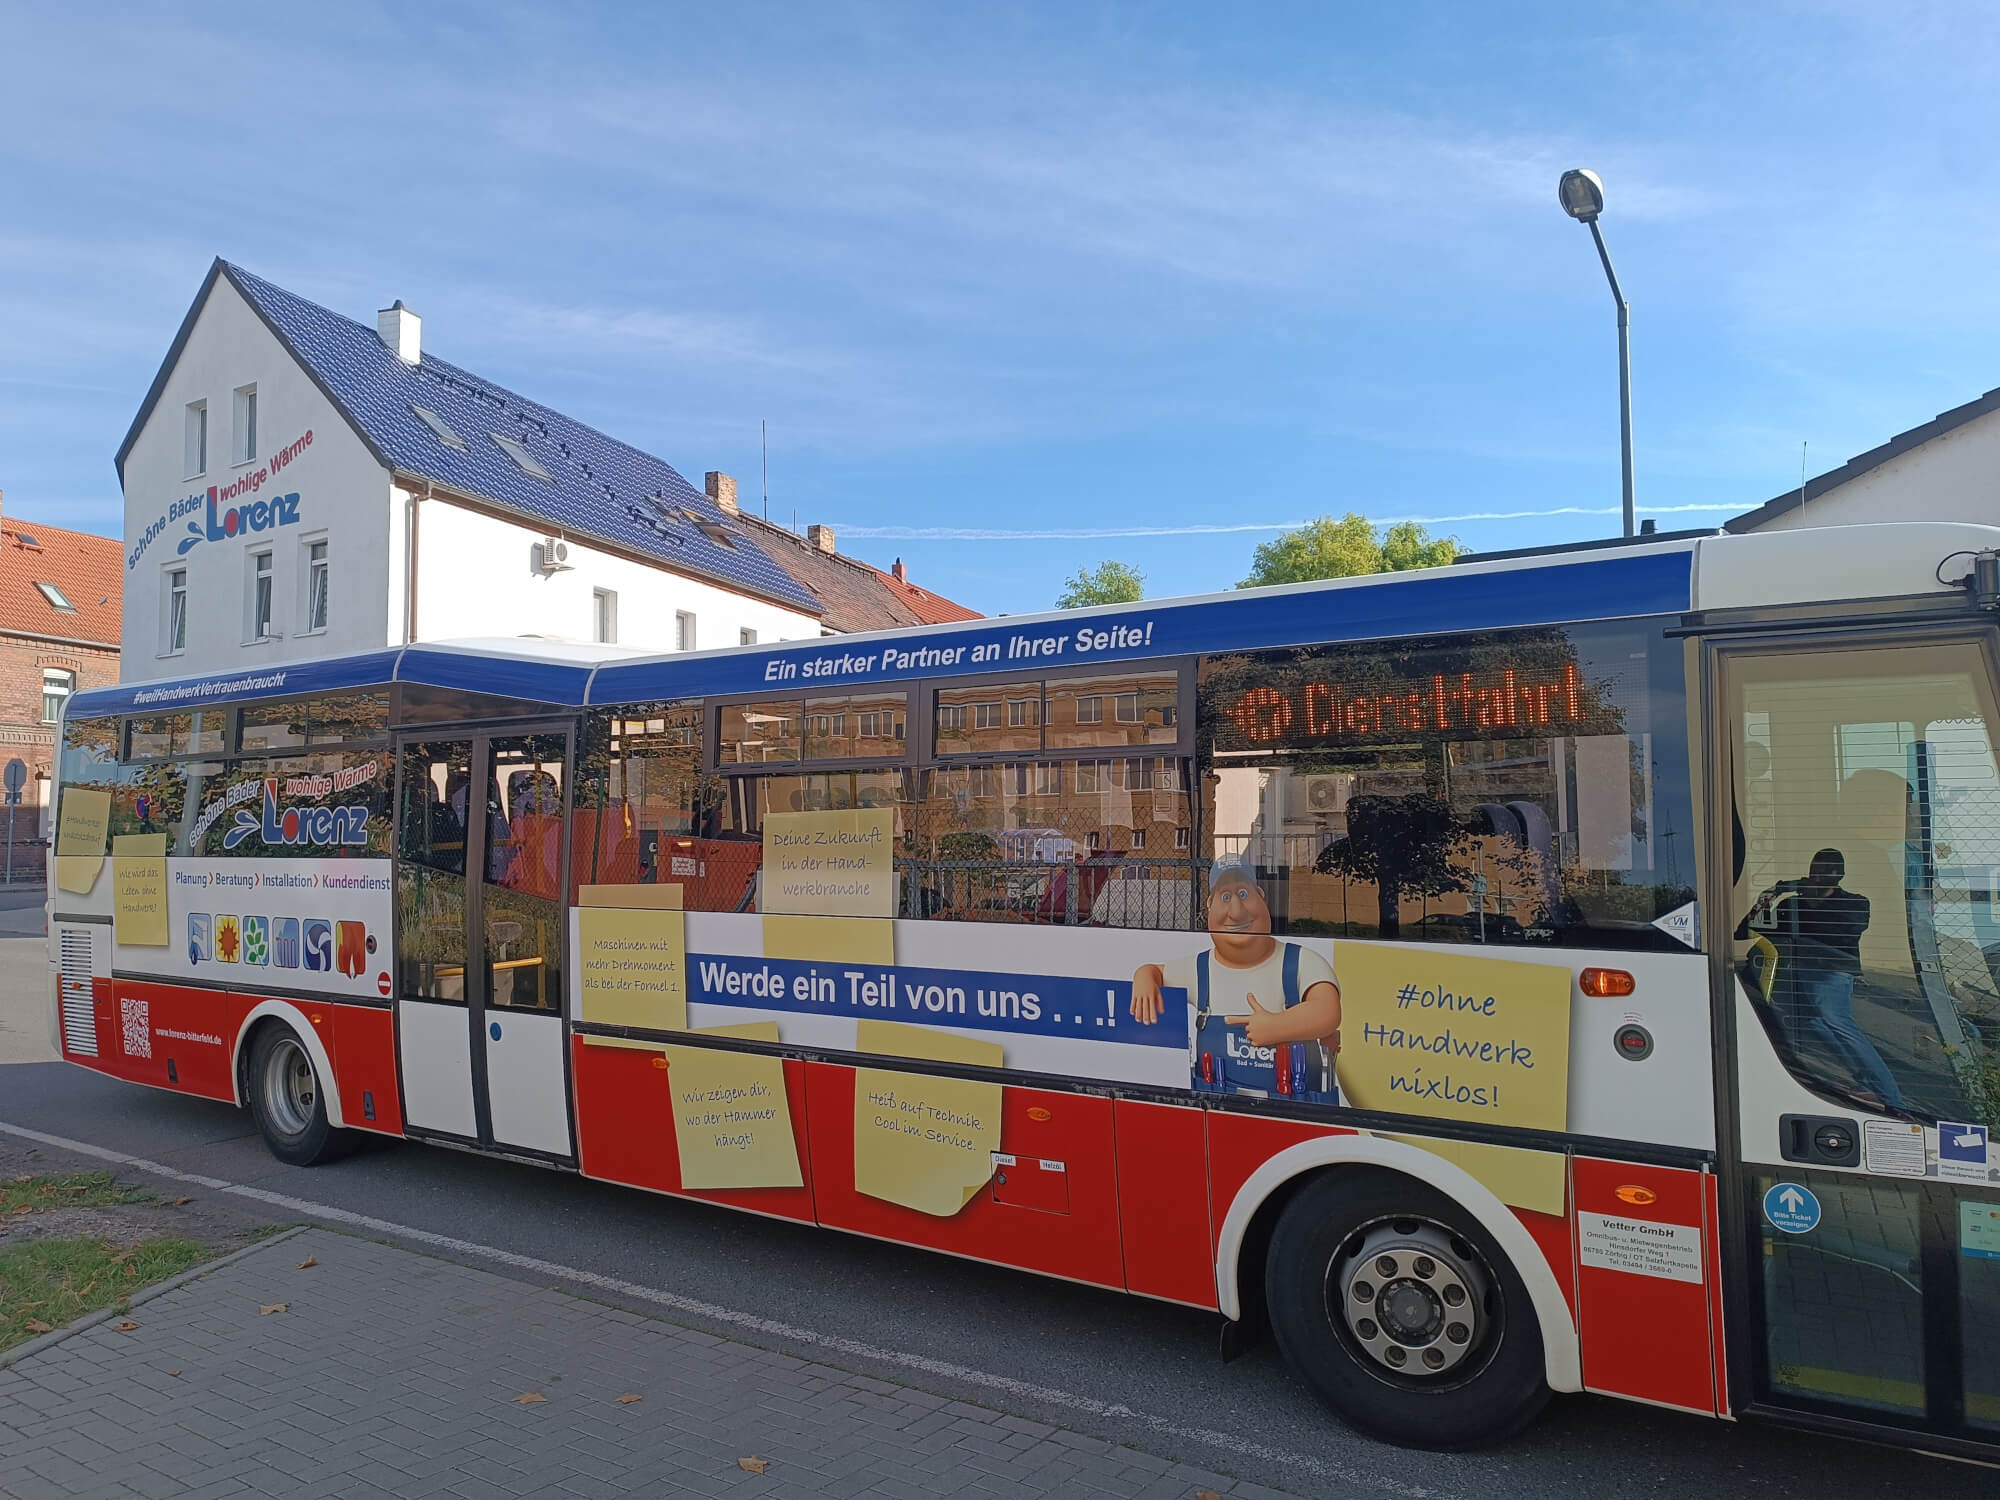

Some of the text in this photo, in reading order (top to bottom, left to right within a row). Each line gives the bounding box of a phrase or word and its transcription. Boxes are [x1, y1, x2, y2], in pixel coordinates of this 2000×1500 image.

[219, 428, 314, 503] wohlige Wärme
[206, 485, 301, 542] Lorenz
[128, 493, 205, 571] schöne Bäder
[764, 622, 1154, 682] Ein starker Partner an Ihrer Seite!
[133, 672, 287, 705] #weilHandwerkVertrauenbraucht
[286, 760, 378, 801] wohlige Wärme
[189, 779, 261, 848] schöne Bäder
[262, 777, 369, 846] Lorenz
[774, 826, 883, 848] Deine Zukunft
[782, 854, 873, 871] in der Hand-
[175, 871, 391, 890] Planung Beratung Installation Kundendienst
[783, 880, 871, 897] werkbranche
[593, 937, 669, 951] Maschinen mit
[586, 958, 676, 972] mehr Drehmoment
[585, 976, 681, 993] als bei der Formel 1.
[699, 961, 785, 998] Werde
[792, 968, 836, 1003] ein
[843, 971, 896, 1009] Teil
[904, 984, 965, 1017] von
[976, 989, 1042, 1021] uns
[1396, 983, 1497, 1017] #ohne
[155, 1028, 222, 1045] www.lorenz-bitterfeld.de
[1363, 1022, 1535, 1069] Handwerk
[682, 1081, 771, 1104] Wir zeigen dir,
[1389, 1067, 1499, 1108] nixlos!
[685, 1108, 777, 1126] wo der Hammer
[868, 1091, 985, 1131] Heiß auf Technik.
[714, 1132, 755, 1150] hängt!
[874, 1116, 977, 1151] Cool im Service.
[1586, 1231, 1621, 1242] Omnibus-
[1602, 1219, 1675, 1238] Vetter GmbH
[1648, 1248, 1665, 1258] Weg
